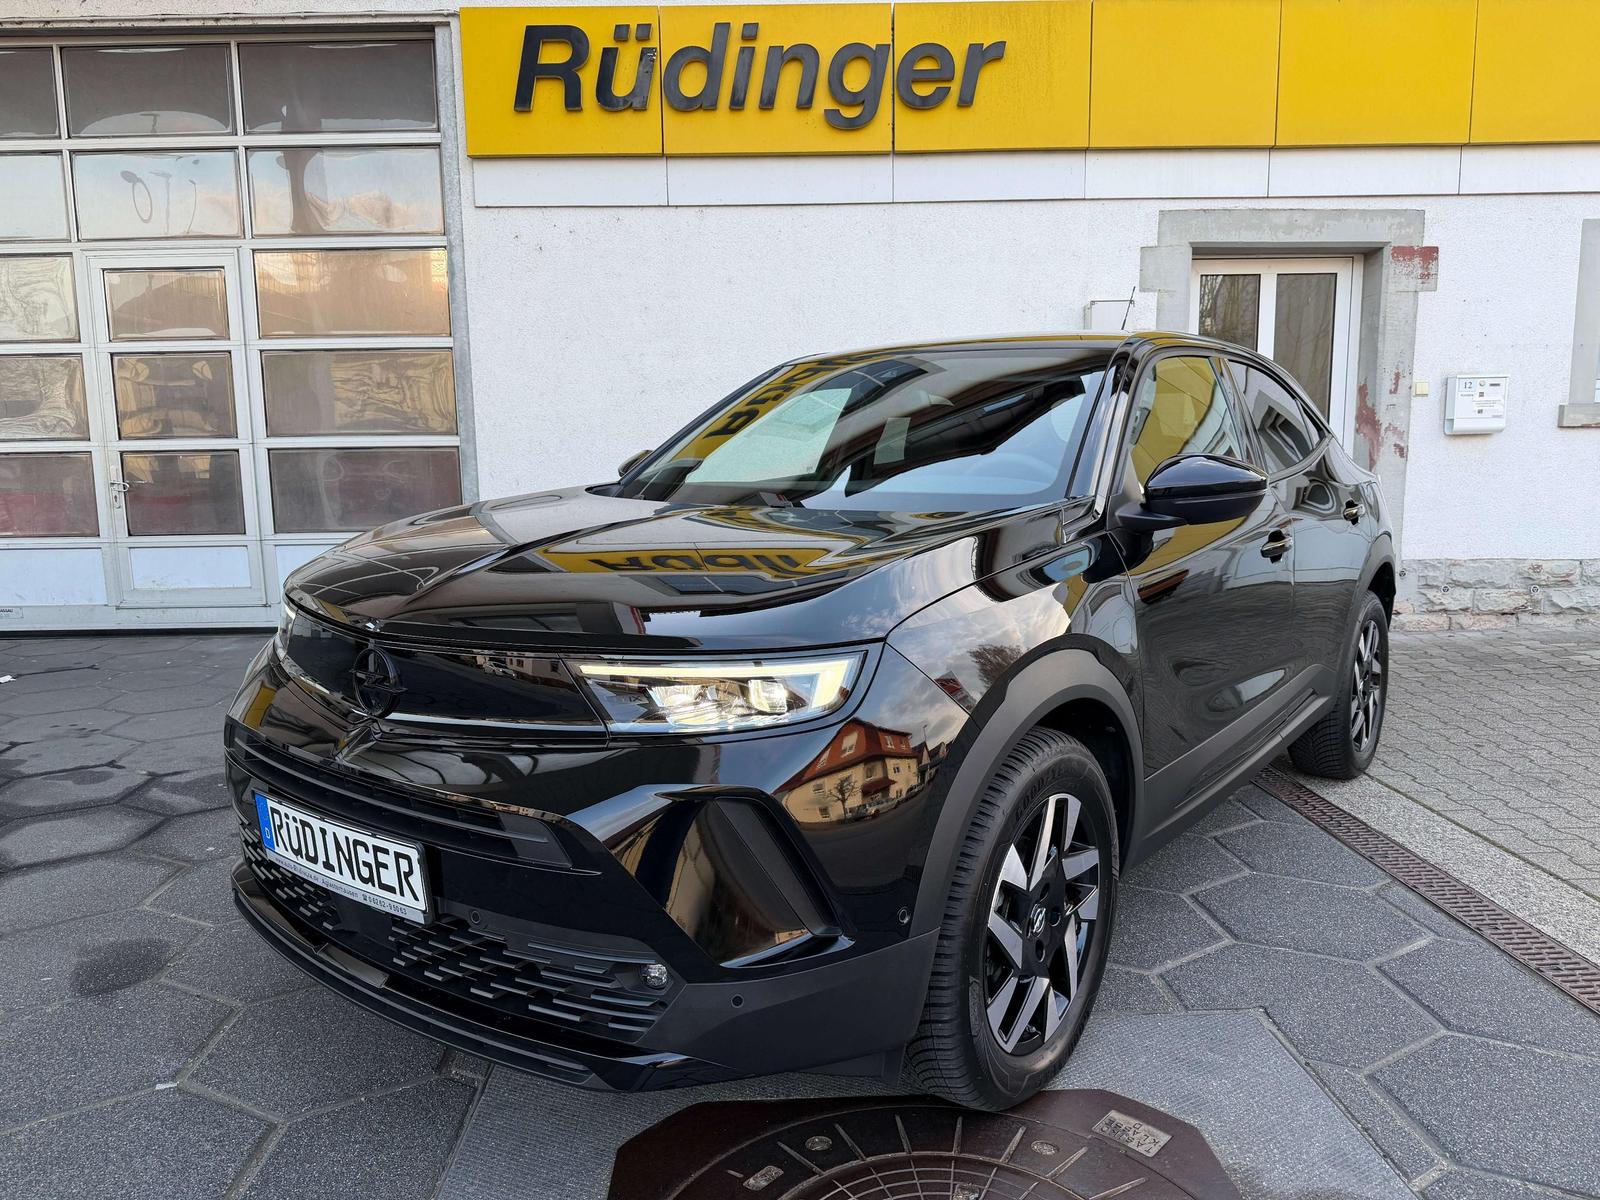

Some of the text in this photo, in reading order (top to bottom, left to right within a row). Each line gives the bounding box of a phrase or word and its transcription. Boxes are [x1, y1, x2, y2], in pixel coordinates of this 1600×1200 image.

[513, 21, 1008, 130] Rüdinger
[1464, 381, 1473, 389] 12
[269, 806, 420, 902] RÜDINGER
